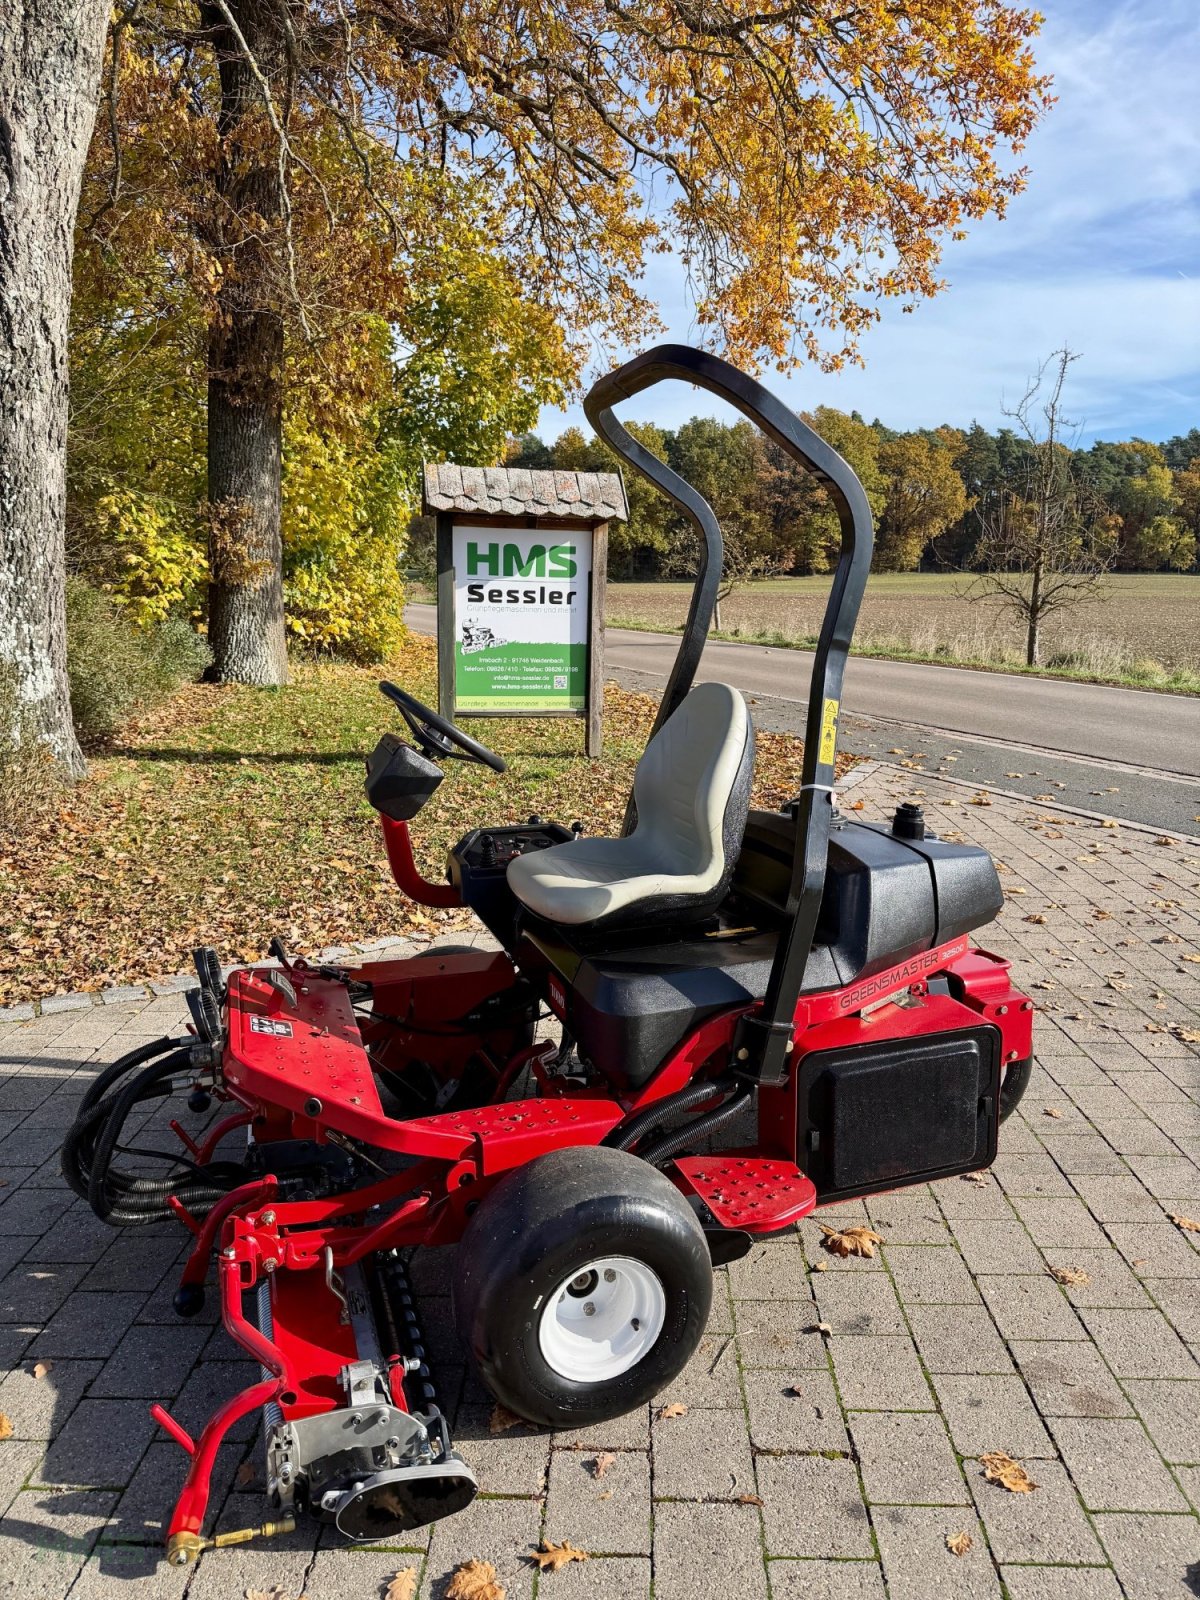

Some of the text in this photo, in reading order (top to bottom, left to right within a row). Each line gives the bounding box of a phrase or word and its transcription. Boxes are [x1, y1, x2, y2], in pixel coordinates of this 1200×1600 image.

[467, 542, 577, 578] HMS
[467, 584, 577, 605] Sessler
[840, 952, 938, 1009] GREENSMASTER
